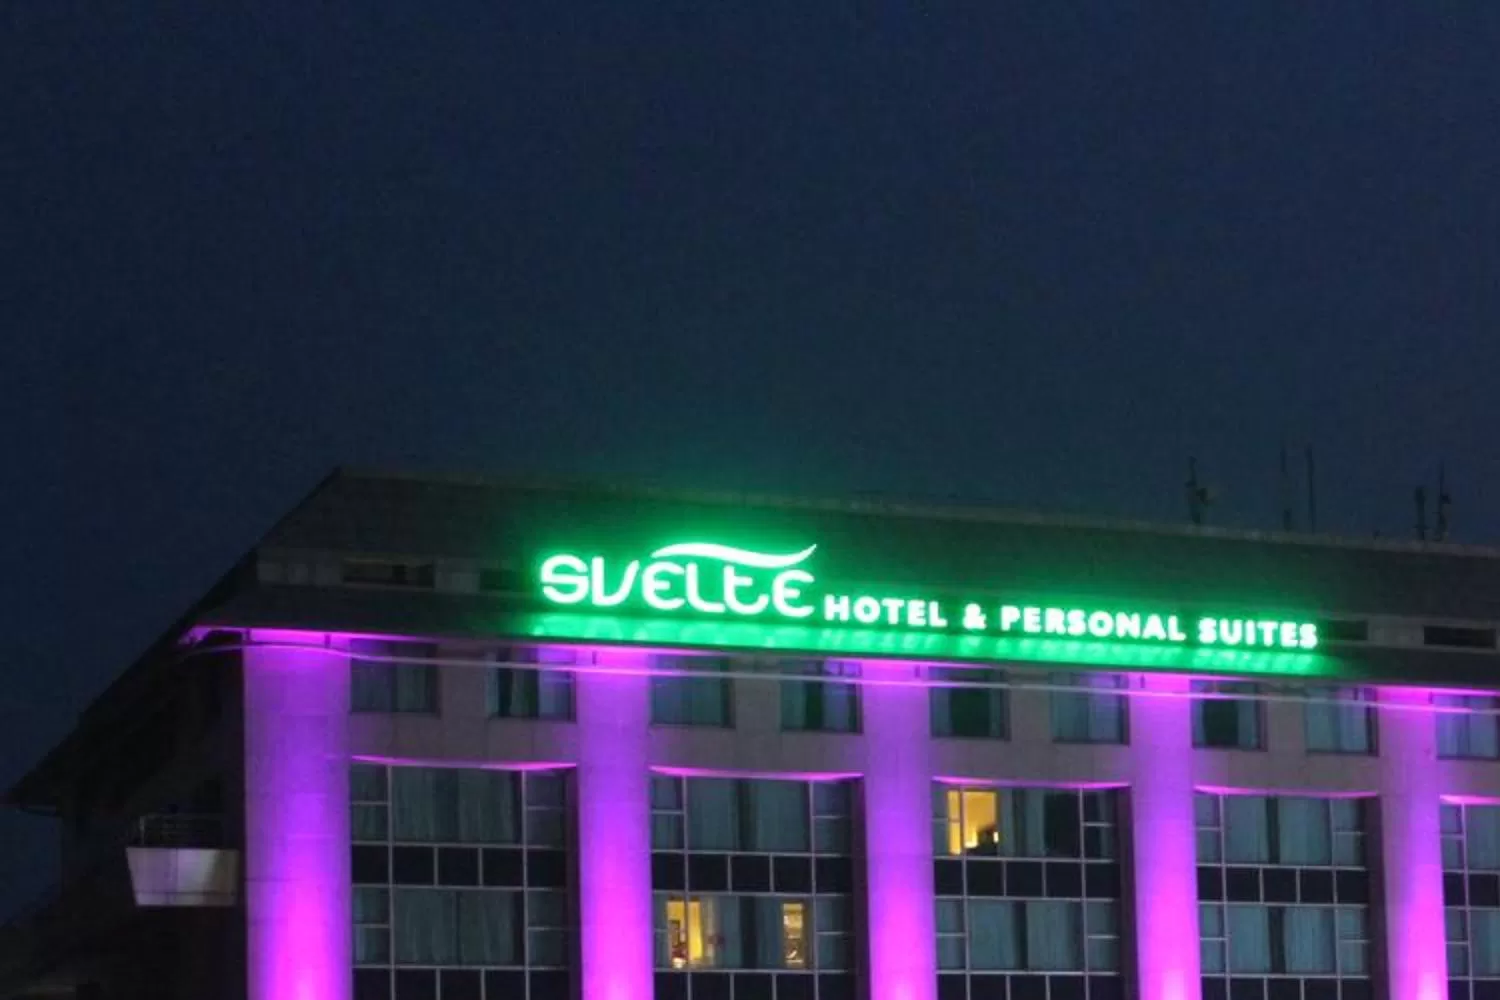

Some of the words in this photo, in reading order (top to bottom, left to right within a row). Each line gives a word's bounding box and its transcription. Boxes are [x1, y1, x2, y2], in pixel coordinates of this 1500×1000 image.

[823, 594, 948, 628] HOTEL
[962, 602, 987, 631] &
[1000, 605, 1187, 642] PERSONAL
[1198, 616, 1319, 649] SUITES
